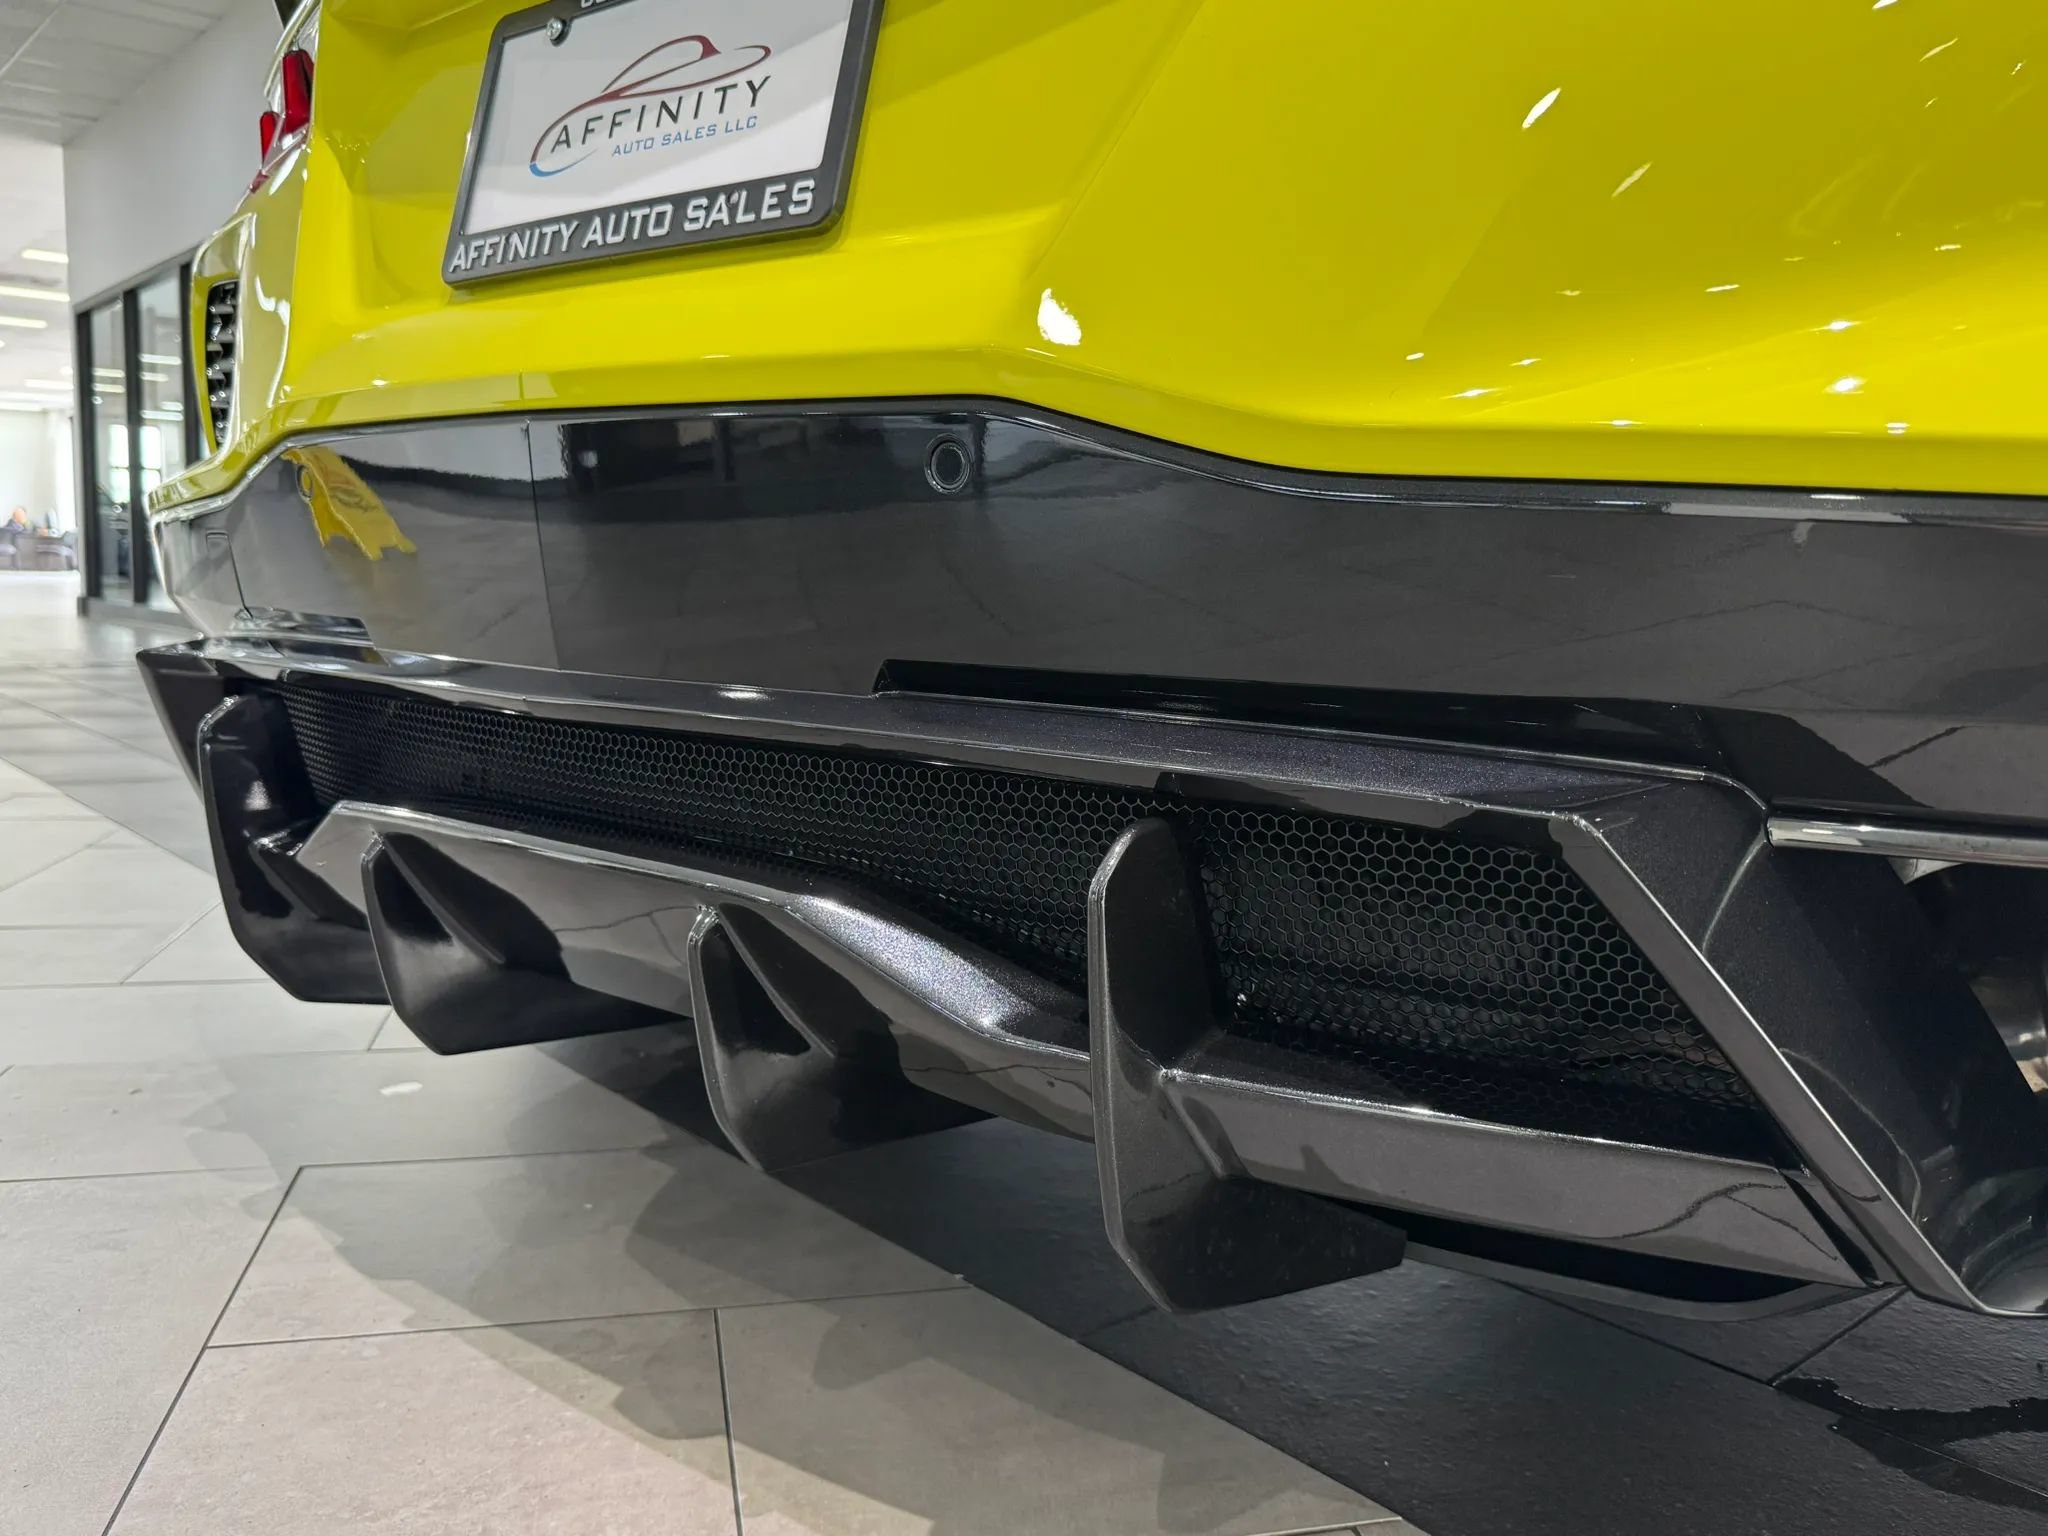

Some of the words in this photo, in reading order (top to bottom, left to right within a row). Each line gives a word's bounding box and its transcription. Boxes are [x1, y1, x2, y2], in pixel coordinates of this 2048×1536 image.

[550, 75, 771, 153] AFFINITY
[611, 137, 655, 157] AUTO
[661, 124, 718, 147] SALES
[724, 115, 758, 133] LLC
[448, 220, 579, 274] AFFINITY
[582, 204, 673, 249] AUTO
[683, 178, 816, 233] SALES
